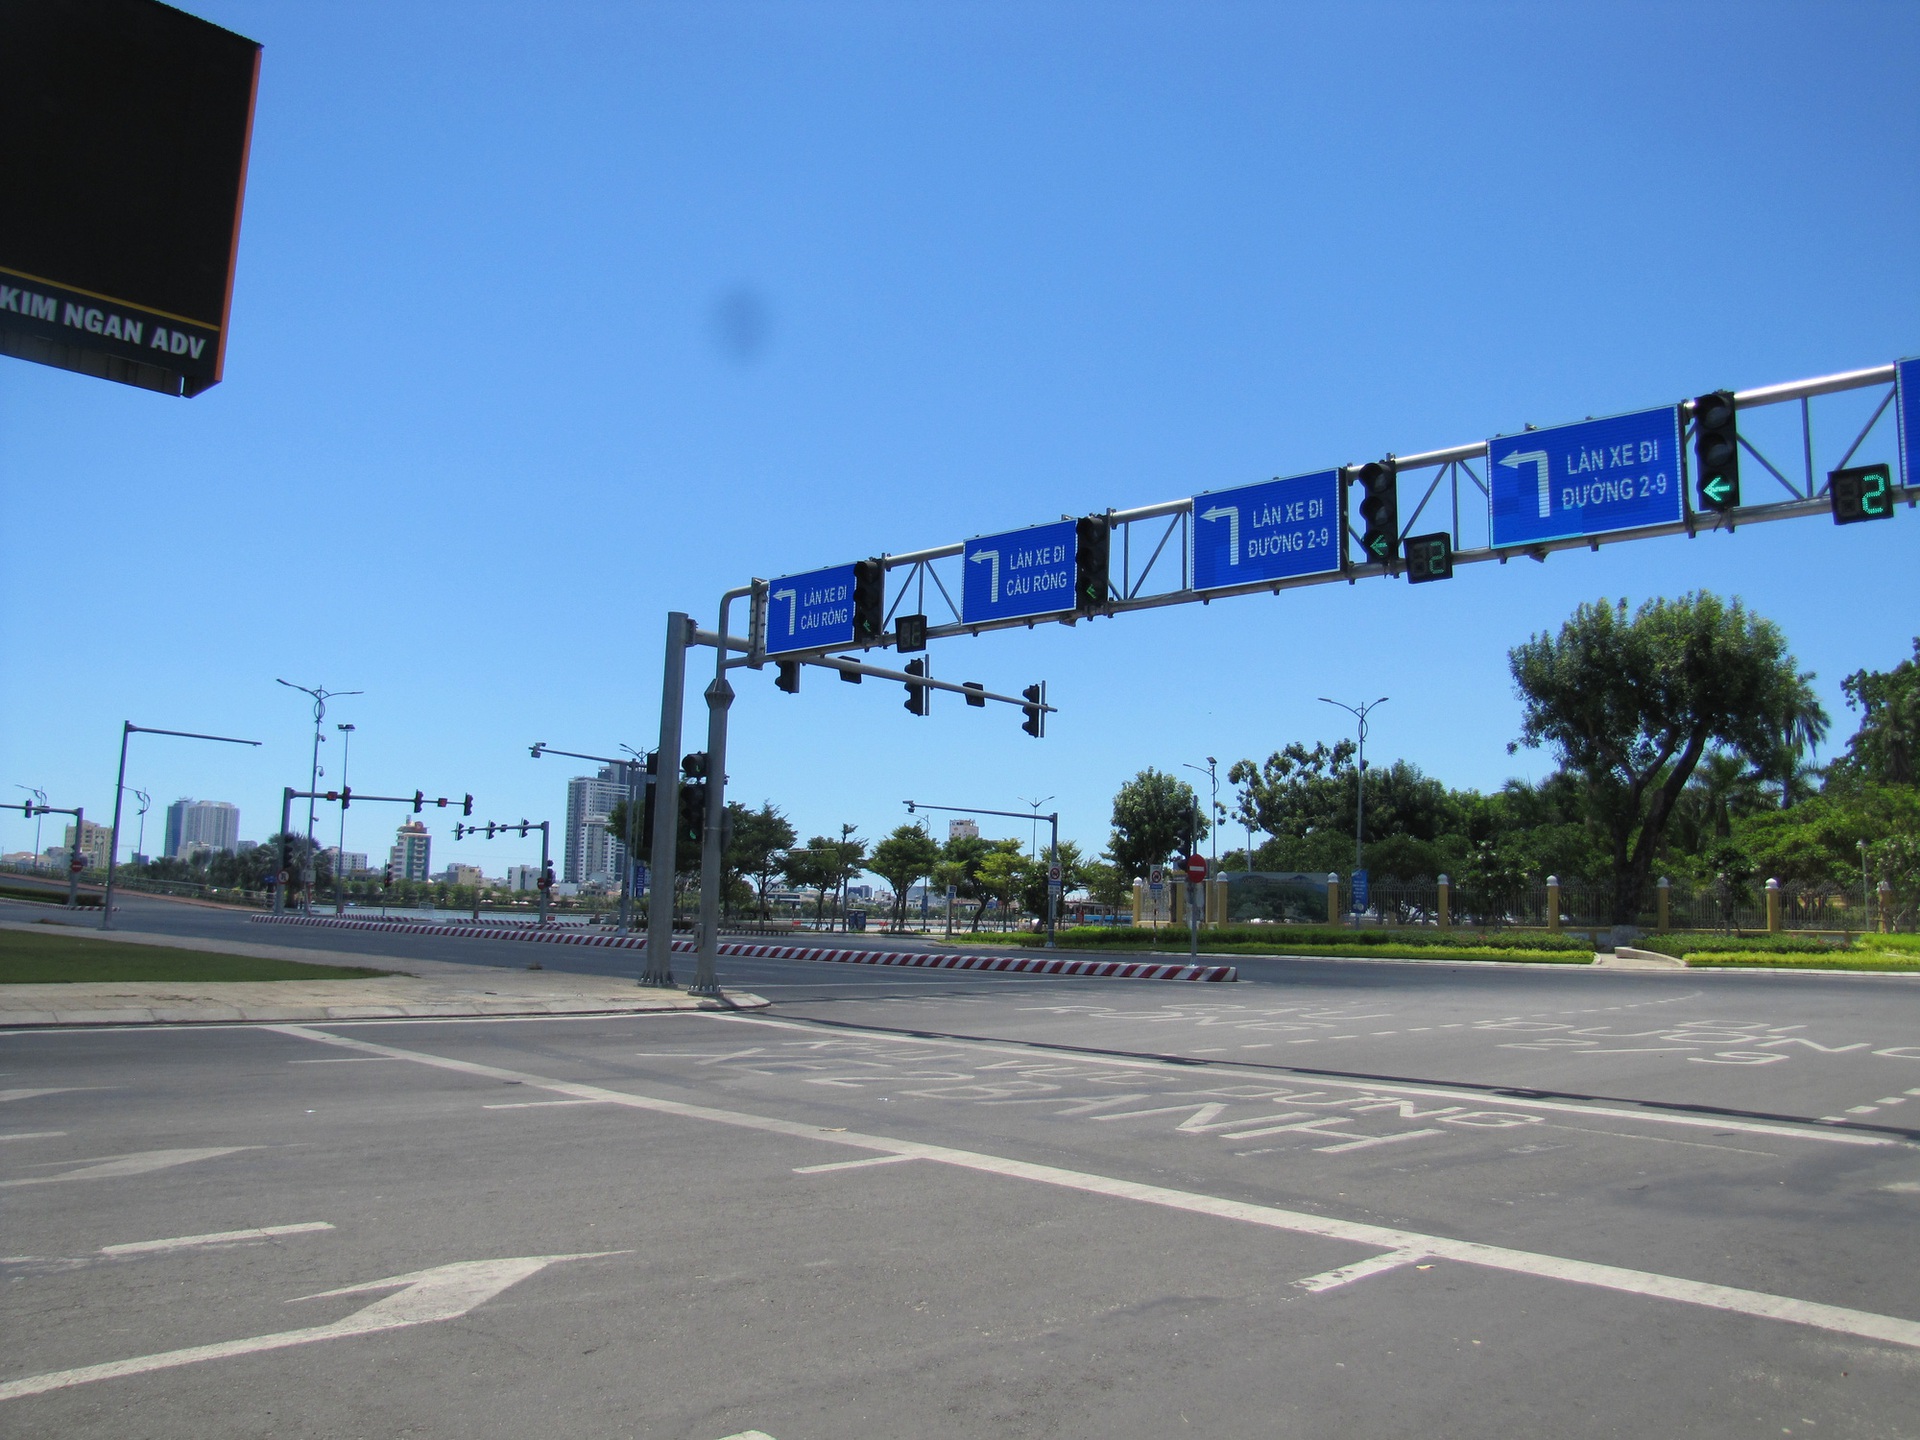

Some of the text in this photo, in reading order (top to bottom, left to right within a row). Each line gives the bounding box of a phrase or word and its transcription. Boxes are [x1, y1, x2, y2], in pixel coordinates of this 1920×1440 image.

[0, 285, 207, 360] KIM NGAN ADV
[1567, 439, 1659, 475] LÀN XE ĐI
[1562, 473, 1668, 510] ĐƯỜNG 2-9
[1861, 473, 1885, 514] 2
[1253, 498, 1323, 528] LÀN XE ĐI
[1010, 545, 1065, 570] LÀN XE ĐI
[1248, 528, 1329, 559] ĐƯỜNG 2-9
[1429, 540, 1446, 574] 2
[804, 585, 847, 607] LÀN XE ĐI
[782, 1039, 964, 1061] KHU
[635, 1047, 895, 1076] XE
[803, 1070, 976, 1088] 2
